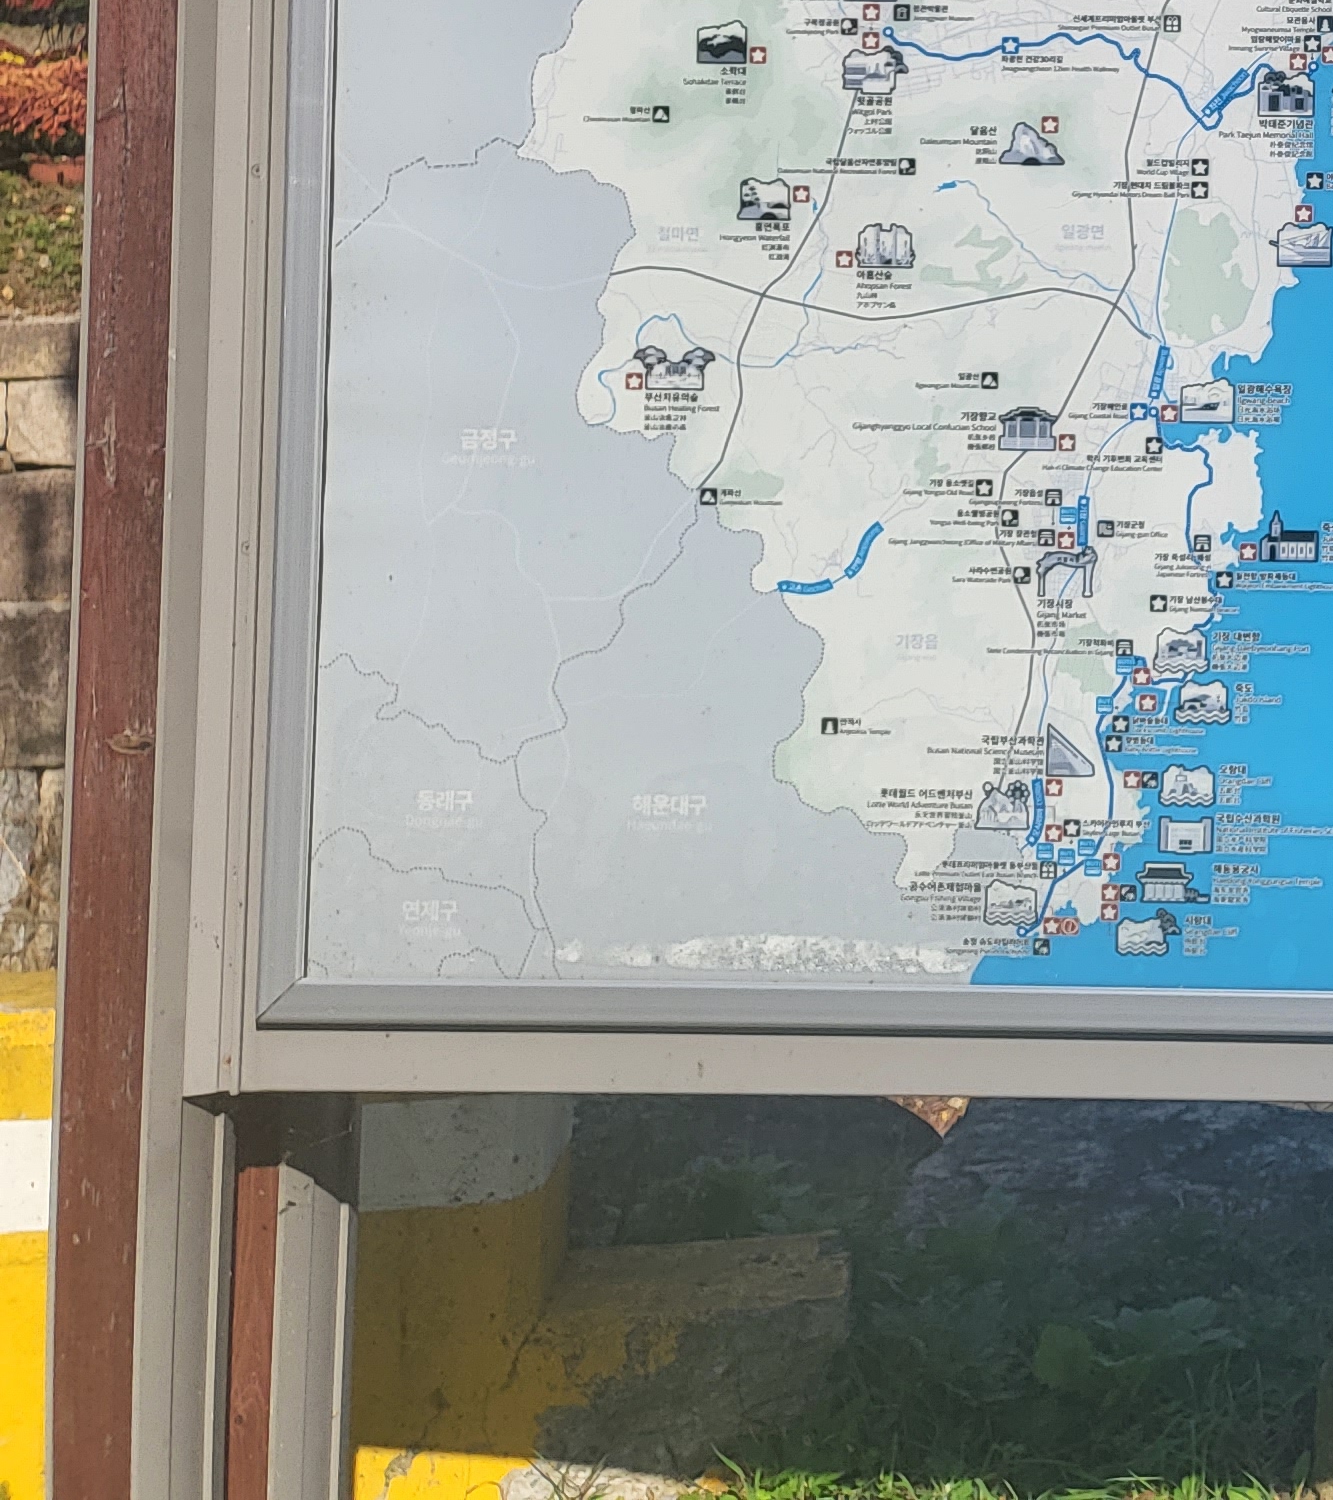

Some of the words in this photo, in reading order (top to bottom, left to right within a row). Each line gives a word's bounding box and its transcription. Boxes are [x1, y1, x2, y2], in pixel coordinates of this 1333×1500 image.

[460, 428, 519, 450] 금정구
[1038, 598, 1073, 610] 기장시장
[416, 789, 474, 813] 동래구
[632, 793, 708, 816] 해운대구
[402, 899, 459, 922] 연제구
